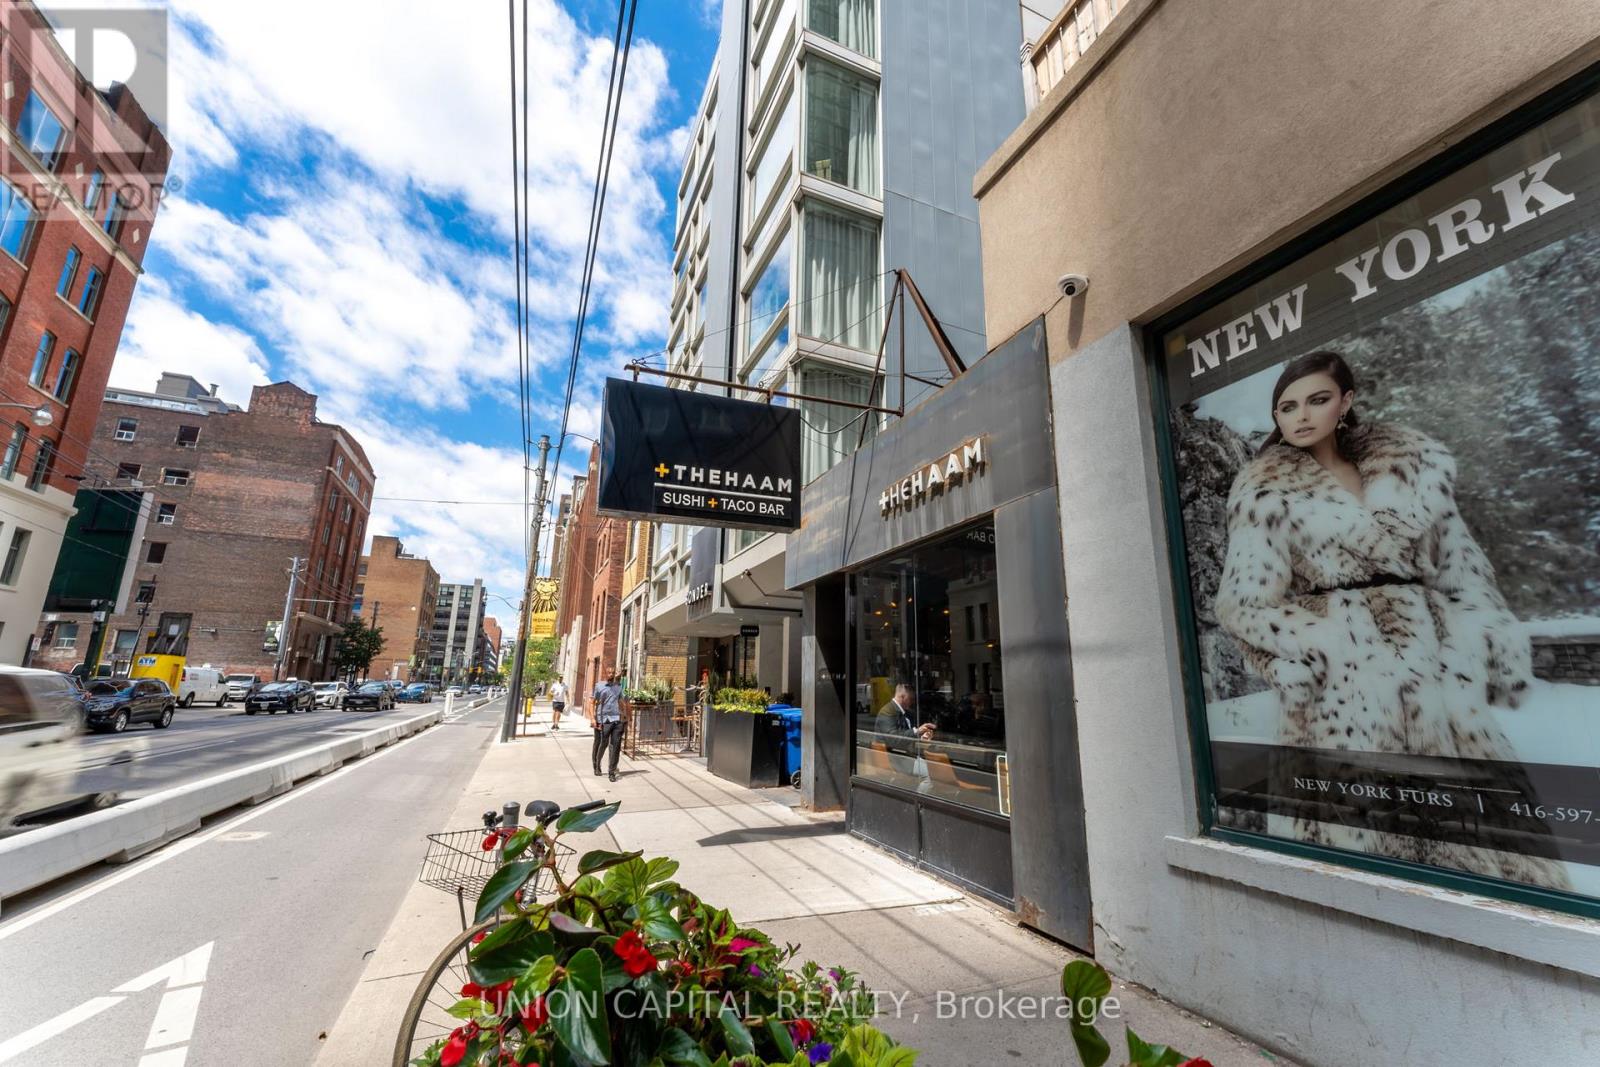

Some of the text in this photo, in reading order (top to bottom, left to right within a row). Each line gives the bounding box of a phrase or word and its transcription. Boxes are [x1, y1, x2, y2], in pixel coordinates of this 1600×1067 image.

[1187, 152, 1575, 378] NEW YORK
[663, 492, 705, 508] SUSHI
[720, 498, 756, 513] TACO
[759, 502, 785, 516] BAR
[138, 656, 156, 665] ATM
[1294, 777, 1331, 792] NEW
[1337, 782, 1392, 800] YORK
[1400, 788, 1453, 808] FURS
